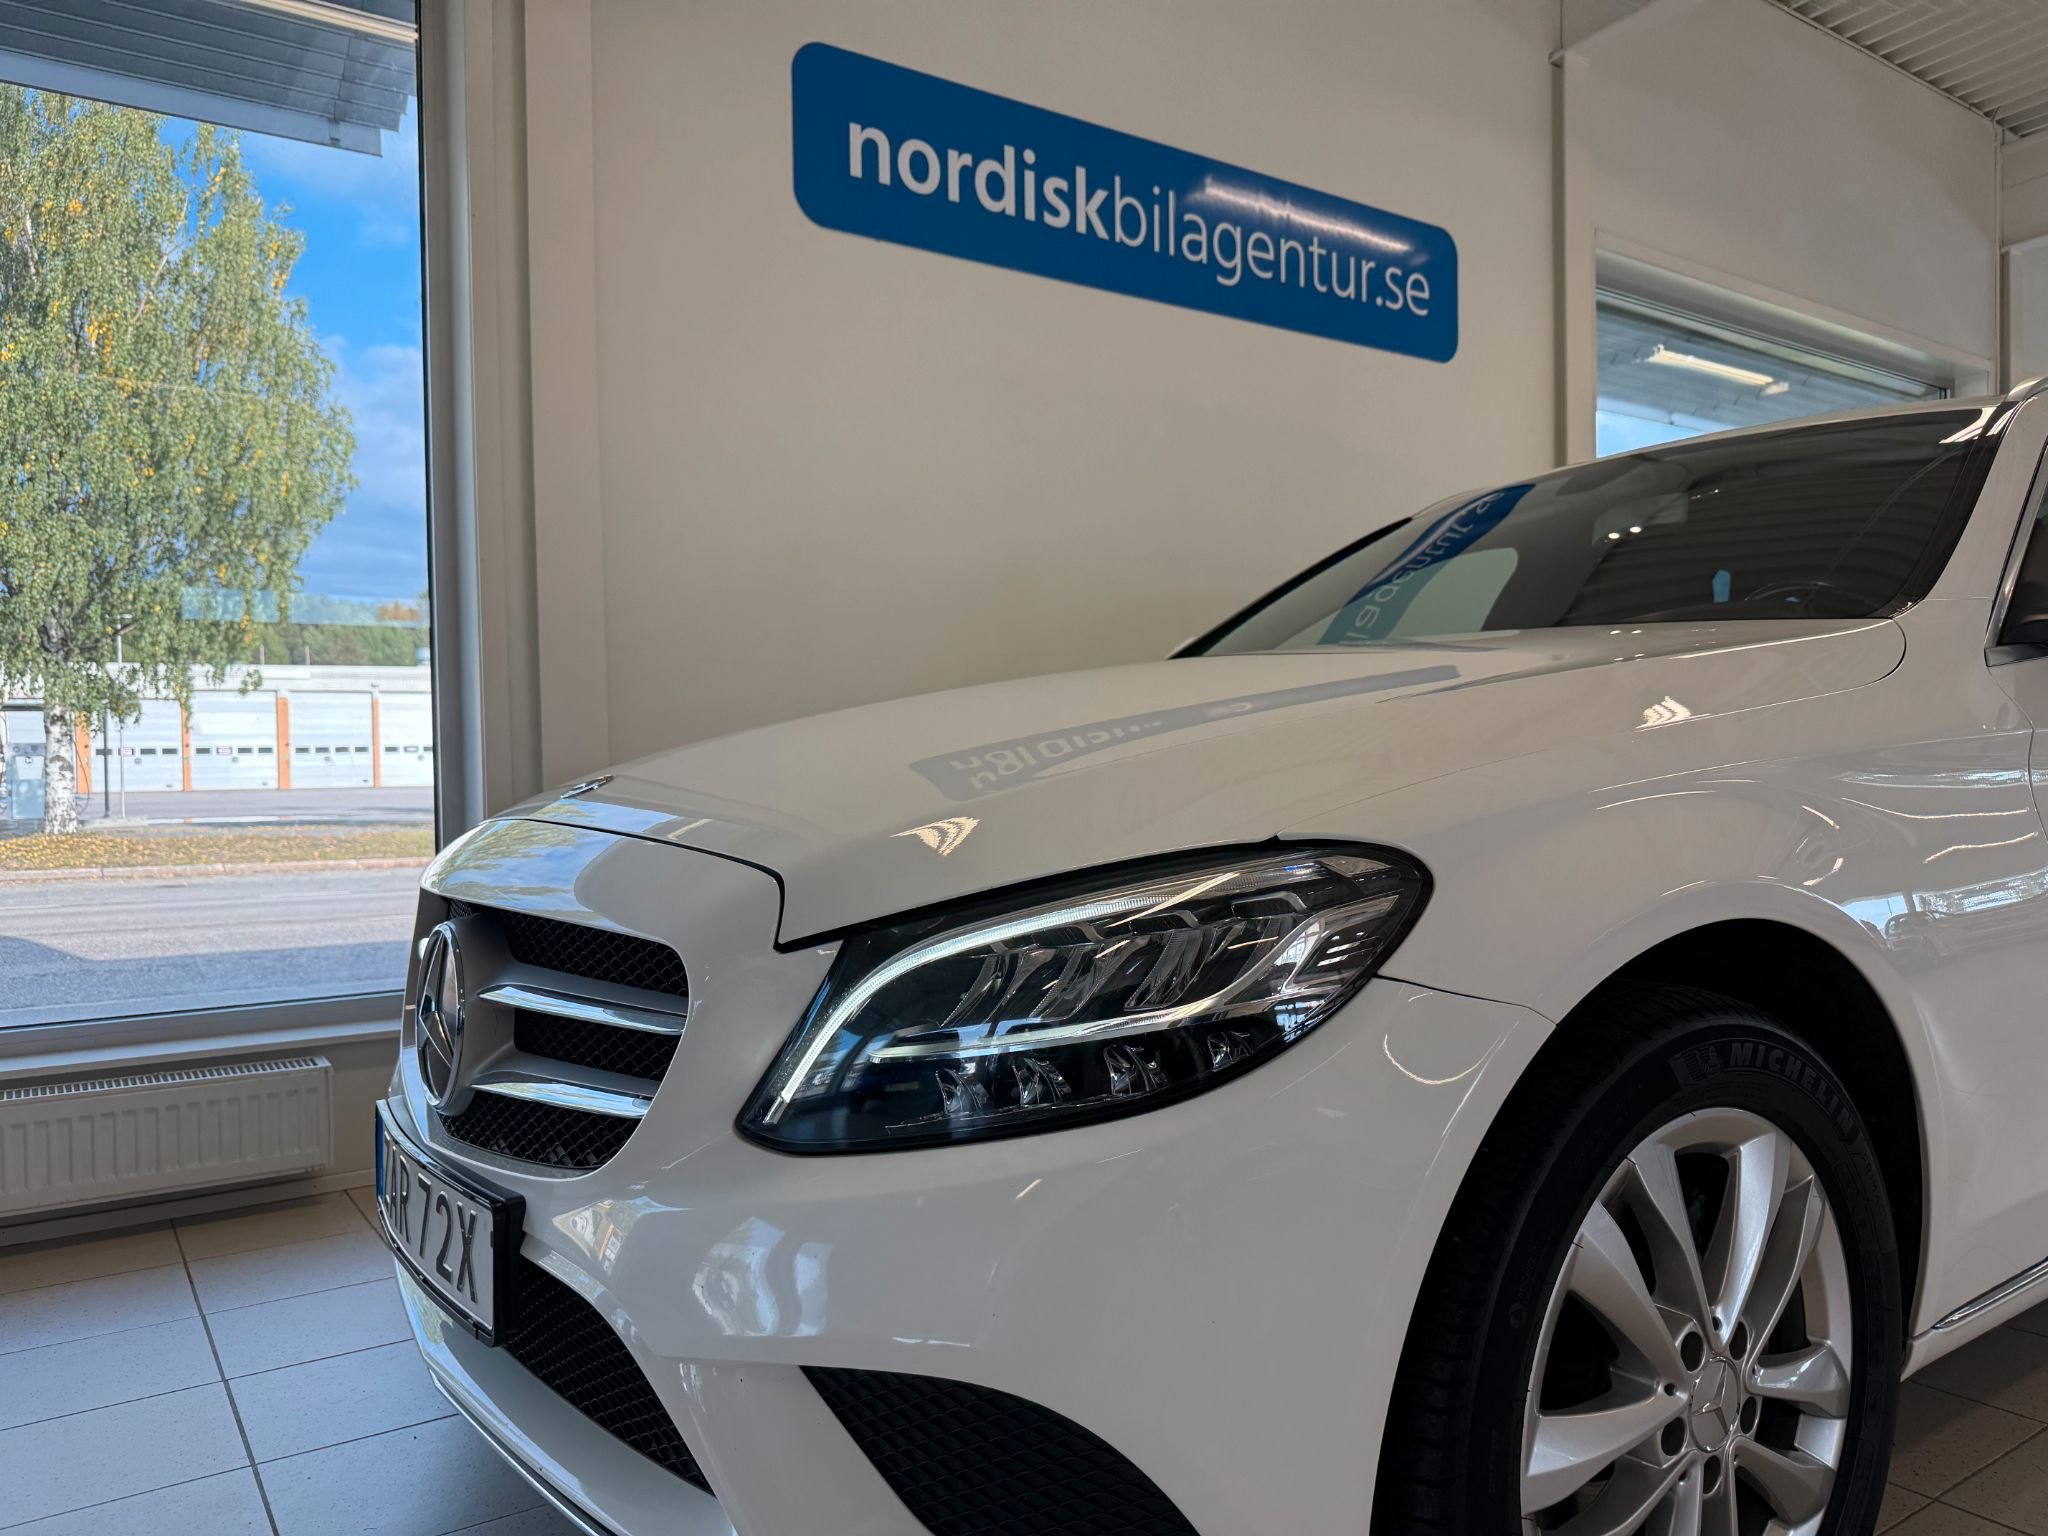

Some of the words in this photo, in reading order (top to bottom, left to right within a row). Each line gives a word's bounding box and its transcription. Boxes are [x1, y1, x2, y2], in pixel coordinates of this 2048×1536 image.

[848, 121, 1430, 317] nordiskbilagentur.se
[1729, 1042, 1855, 1134] MICHELIN
[417, 1171, 479, 1305] 72X
